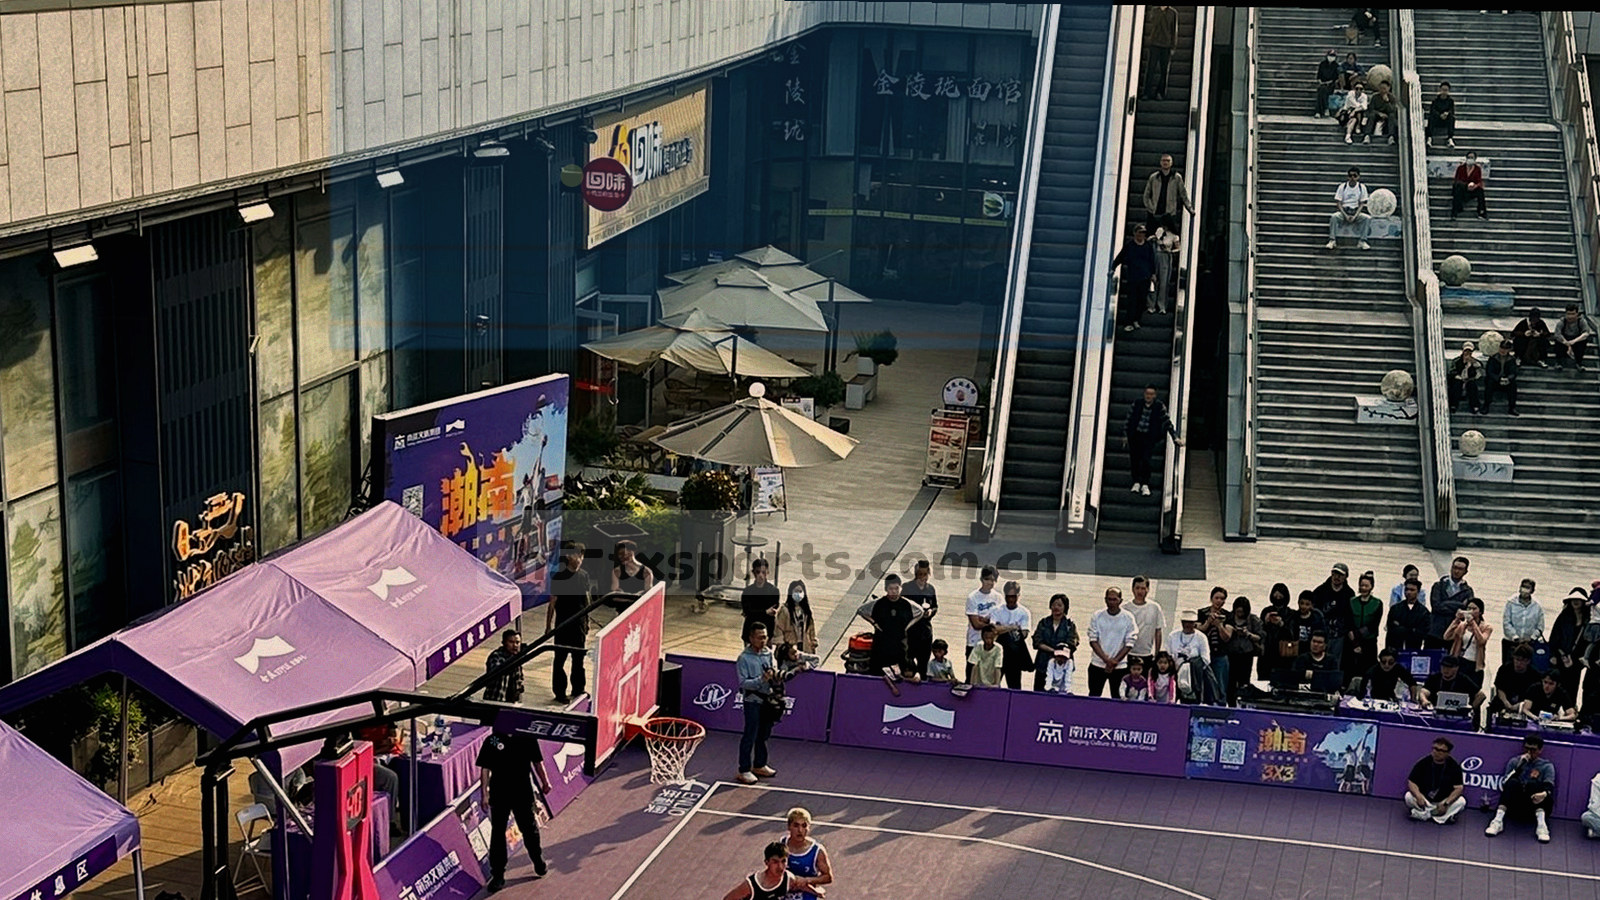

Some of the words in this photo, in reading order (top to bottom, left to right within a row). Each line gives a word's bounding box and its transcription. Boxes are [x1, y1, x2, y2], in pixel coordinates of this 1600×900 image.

[586, 171, 626, 191] 回味
[1069, 725, 1157, 745] 南京文旅集团
[1463, 773, 1504, 791] LDIN
